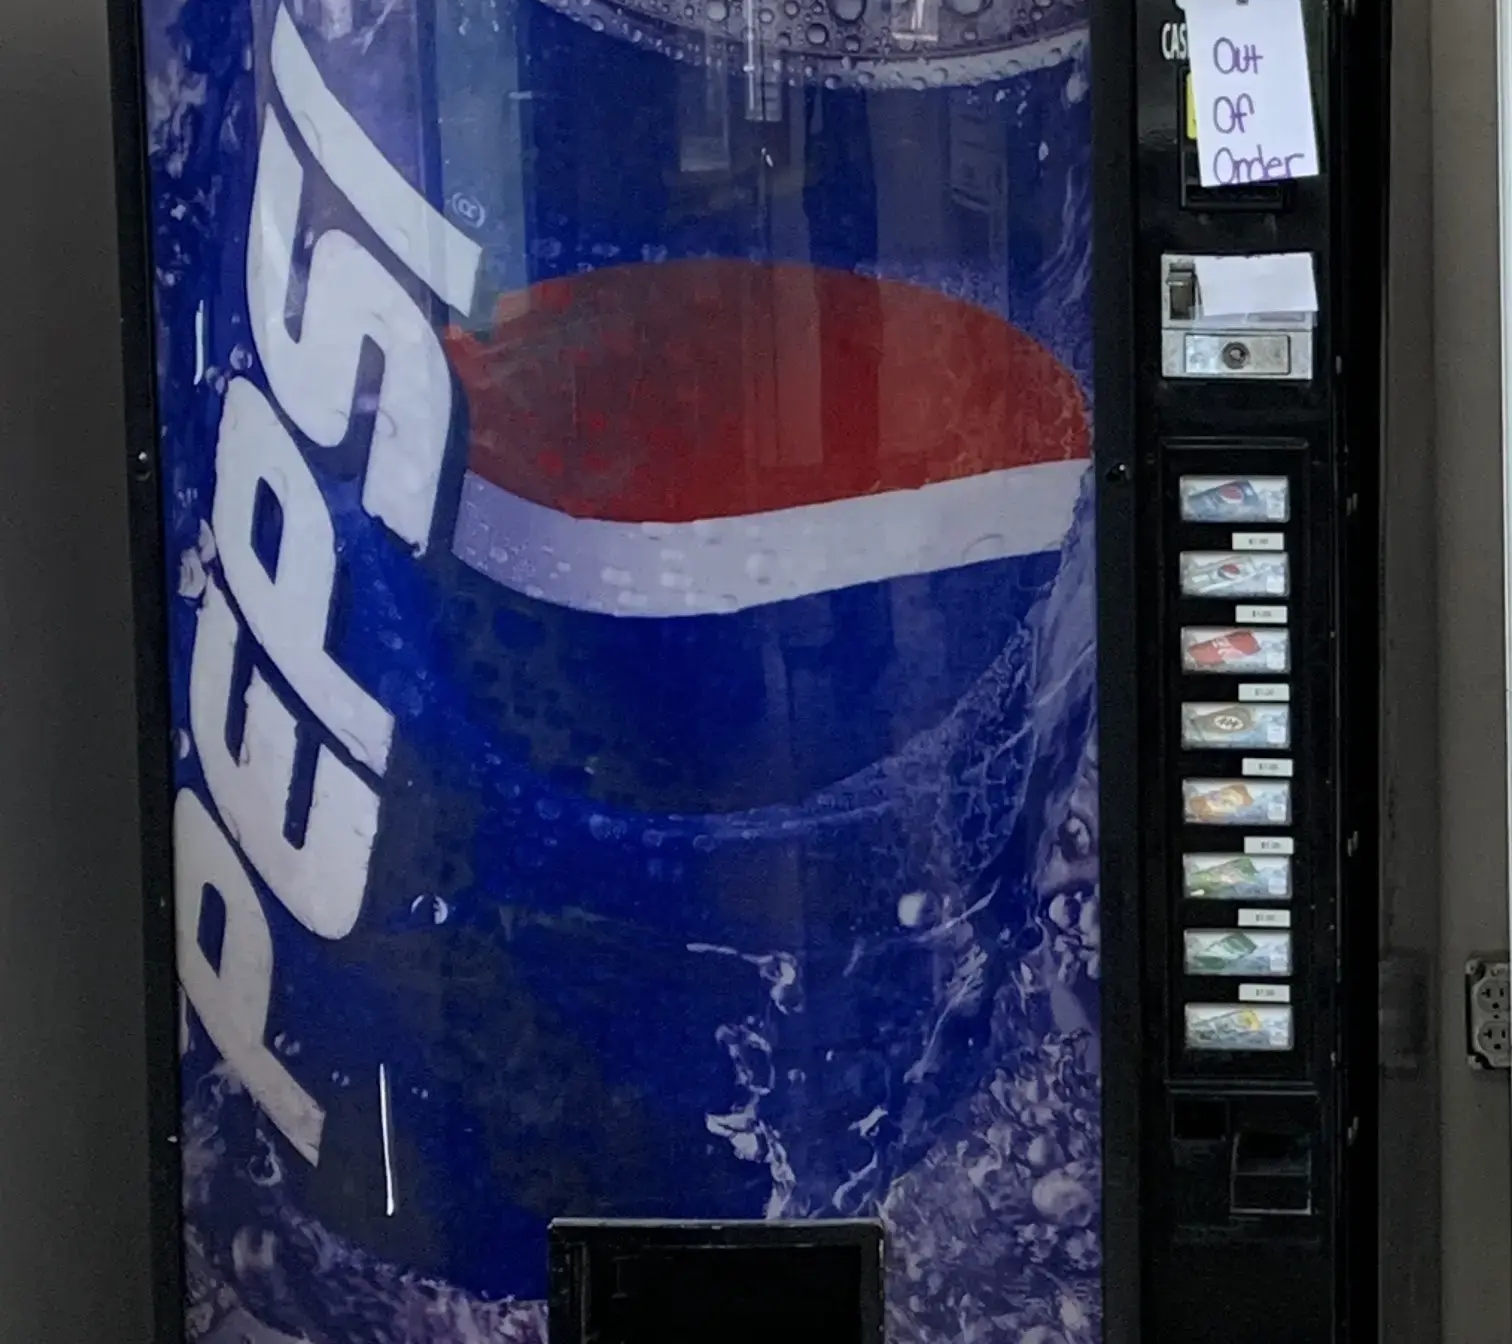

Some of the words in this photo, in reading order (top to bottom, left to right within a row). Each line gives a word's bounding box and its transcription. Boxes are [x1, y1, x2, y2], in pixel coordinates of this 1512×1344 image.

[1213, 38, 1264, 74] Out
[1213, 145, 1306, 185] Order
[174, 2, 482, 1168] PEPSI
